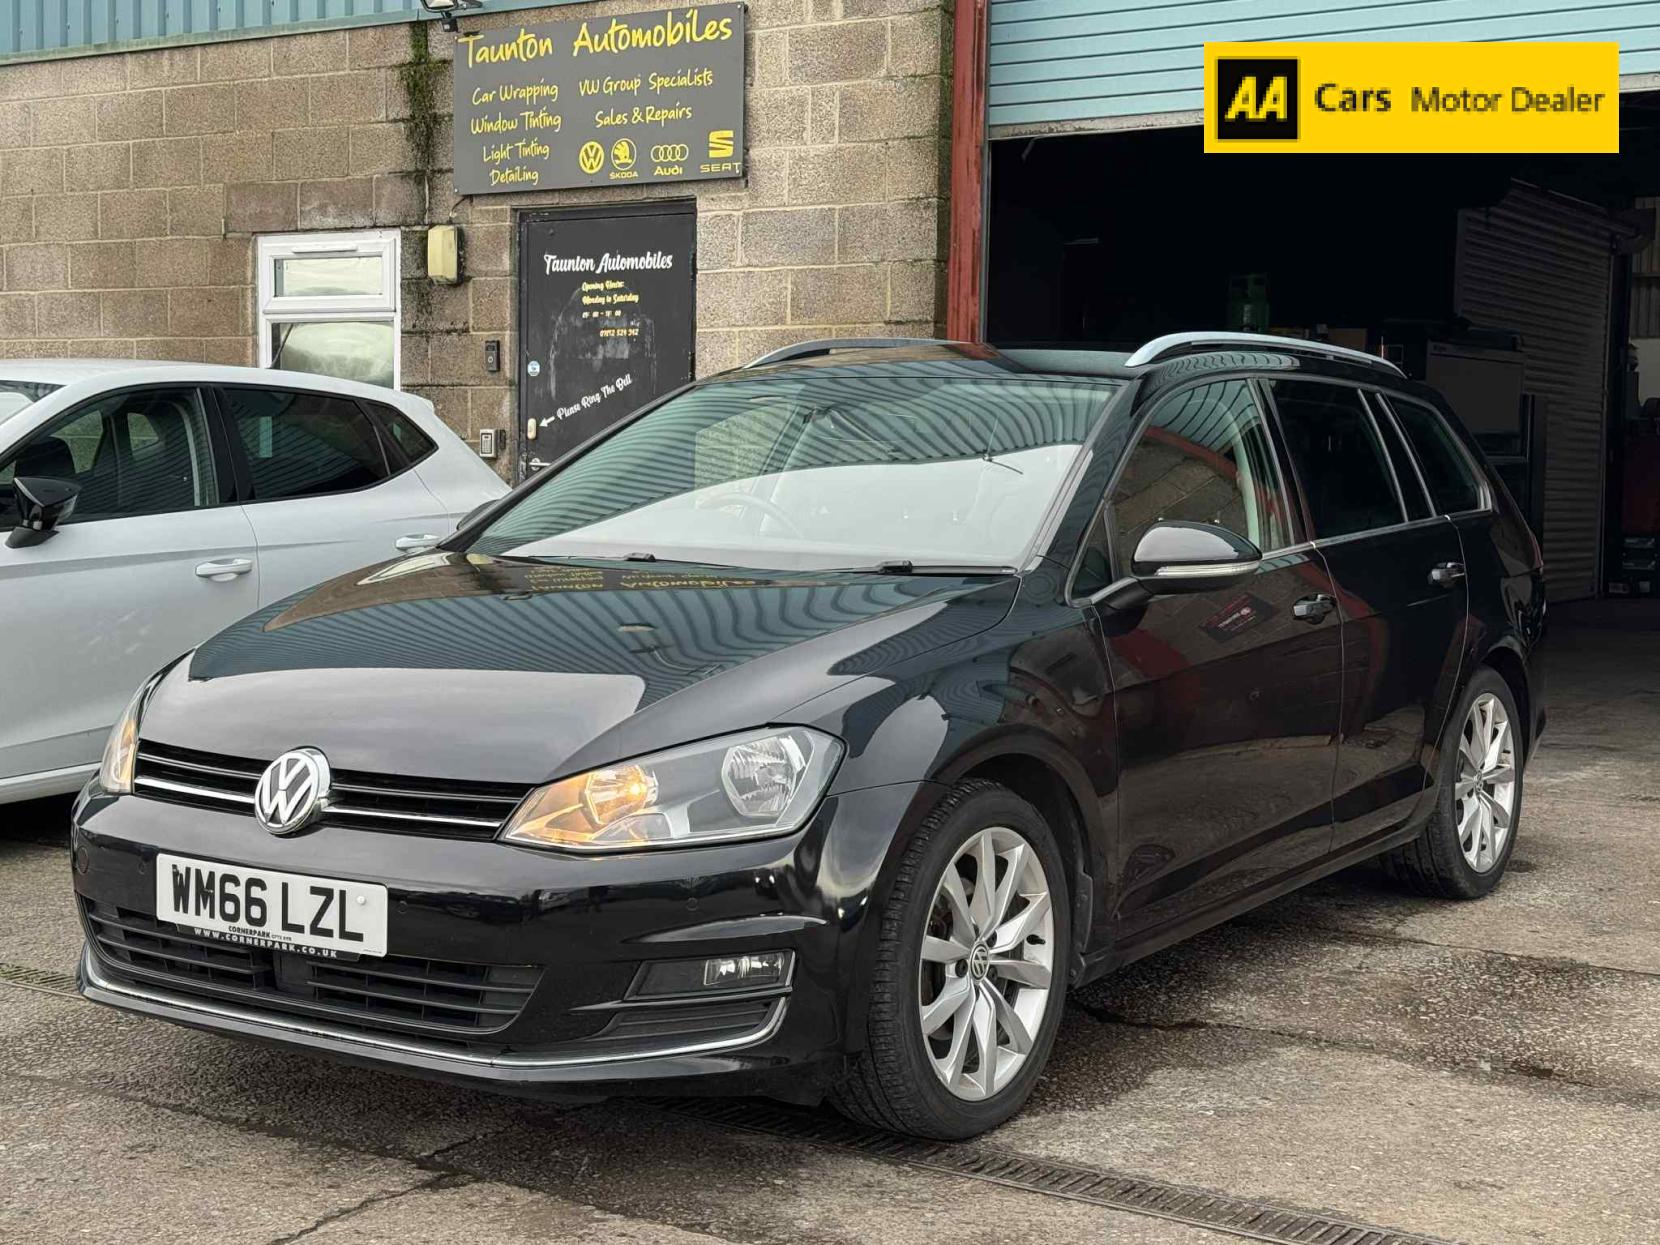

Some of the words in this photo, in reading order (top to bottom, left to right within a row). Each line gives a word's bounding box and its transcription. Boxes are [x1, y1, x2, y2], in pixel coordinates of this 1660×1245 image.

[458, 28, 553, 68] Taunton
[572, 9, 733, 57] Automobiles
[472, 87, 496, 105] Car
[500, 78, 559, 105] Wrapping
[579, 79, 600, 96] VW
[603, 75, 641, 96] Group
[649, 67, 714, 95] Specialists
[471, 112, 518, 134] Window
[520, 106, 561, 133] Tinting
[595, 108, 628, 128] Sales
[632, 107, 644, 123] &
[646, 101, 692, 127] Repairs
[483, 144, 513, 165] Light
[515, 138, 550, 160] Tinting
[490, 166, 539, 186] Detailing
[653, 165, 683, 176] Audi
[700, 162, 742, 174] SEAT
[544, 254, 595, 275] Taunton
[595, 251, 673, 274] Automobiles
[557, 403, 581, 419] Please
[581, 393, 601, 408] Ring
[601, 384, 615, 398] The
[616, 373, 632, 391] Bell
[171, 863, 268, 927] WM66
[281, 881, 364, 942] LZL
[228, 925, 270, 939] CORNERPARK
